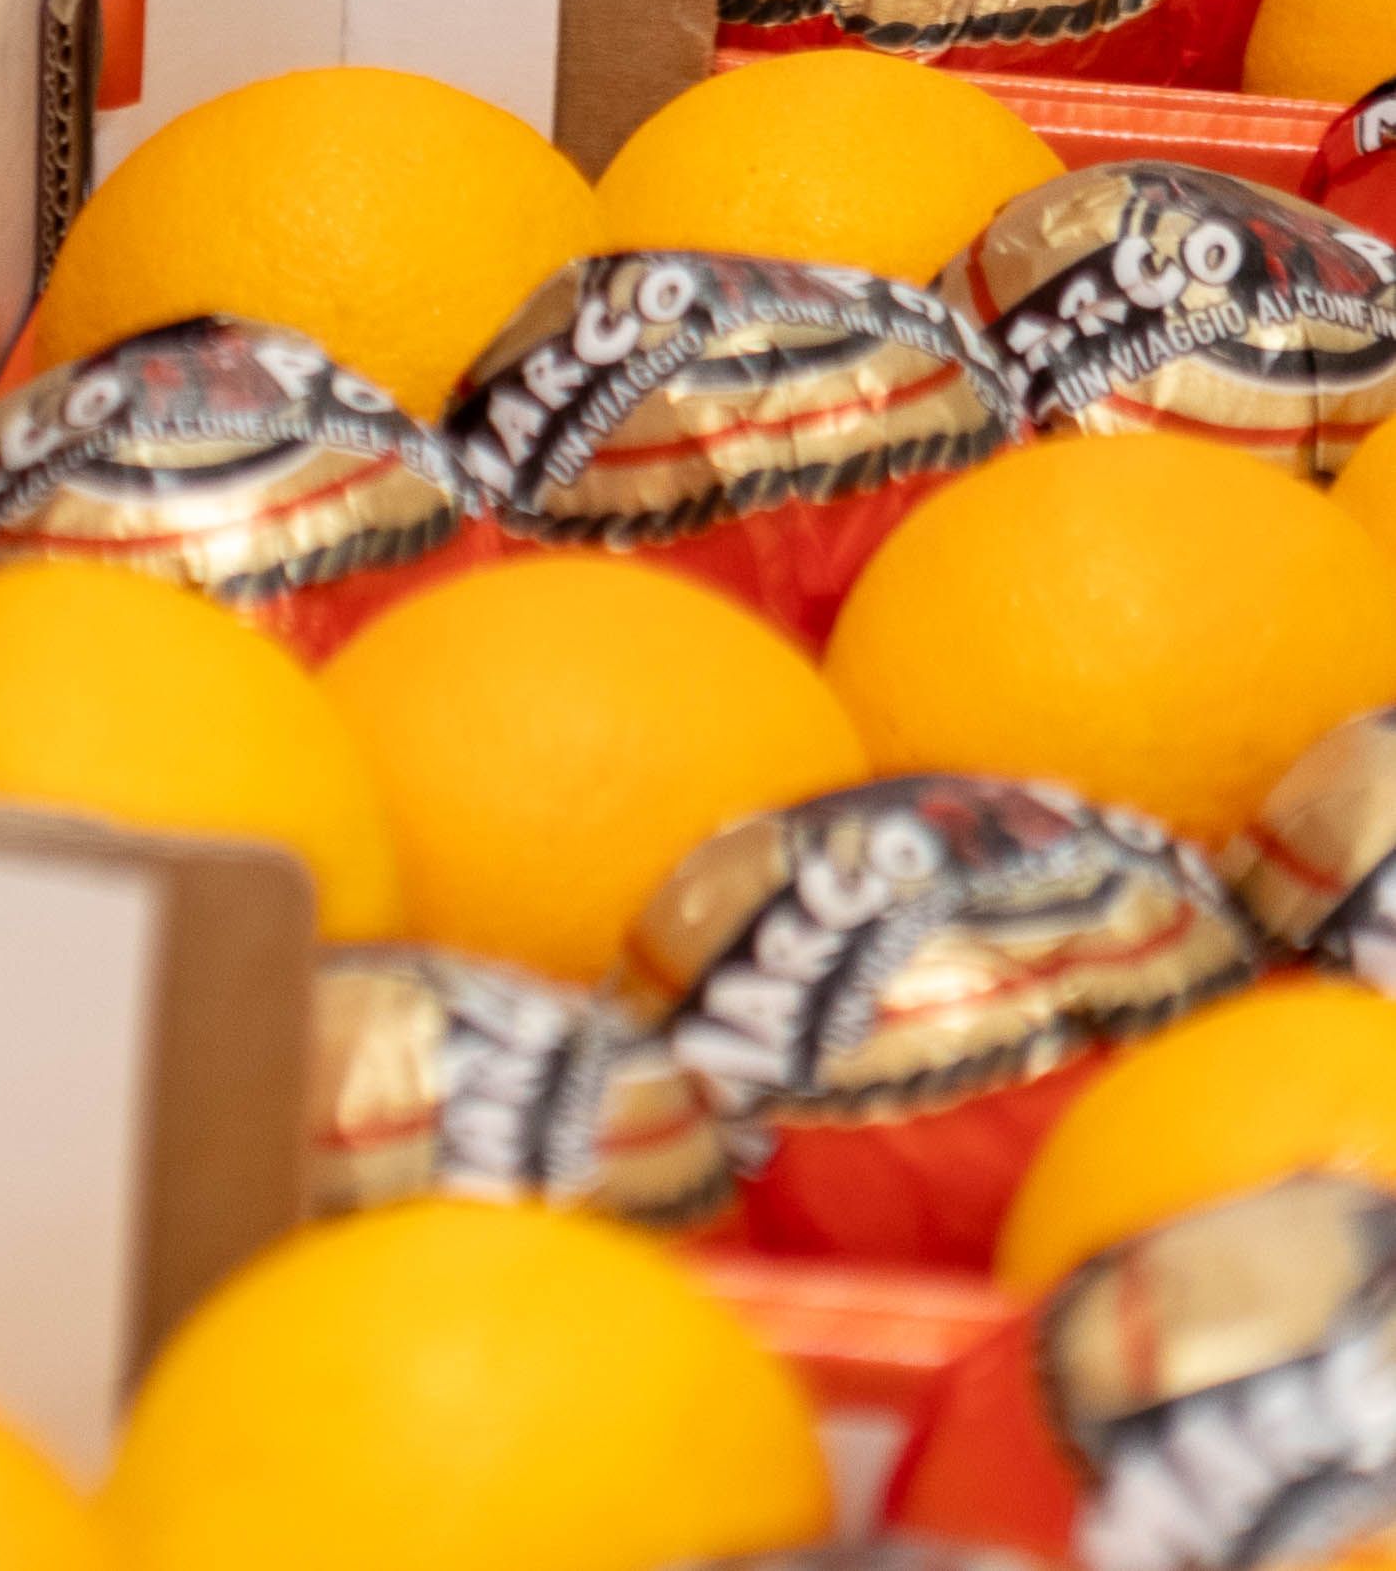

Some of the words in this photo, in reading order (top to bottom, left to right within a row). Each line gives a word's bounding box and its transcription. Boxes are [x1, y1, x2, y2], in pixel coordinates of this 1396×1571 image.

[544, 426, 594, 487] UN
[580, 324, 706, 435] VIAGGIO
[1055, 364, 1113, 411] UN
[1109, 302, 1247, 384] VIAGGIO
[1256, 291, 1292, 326] AI
